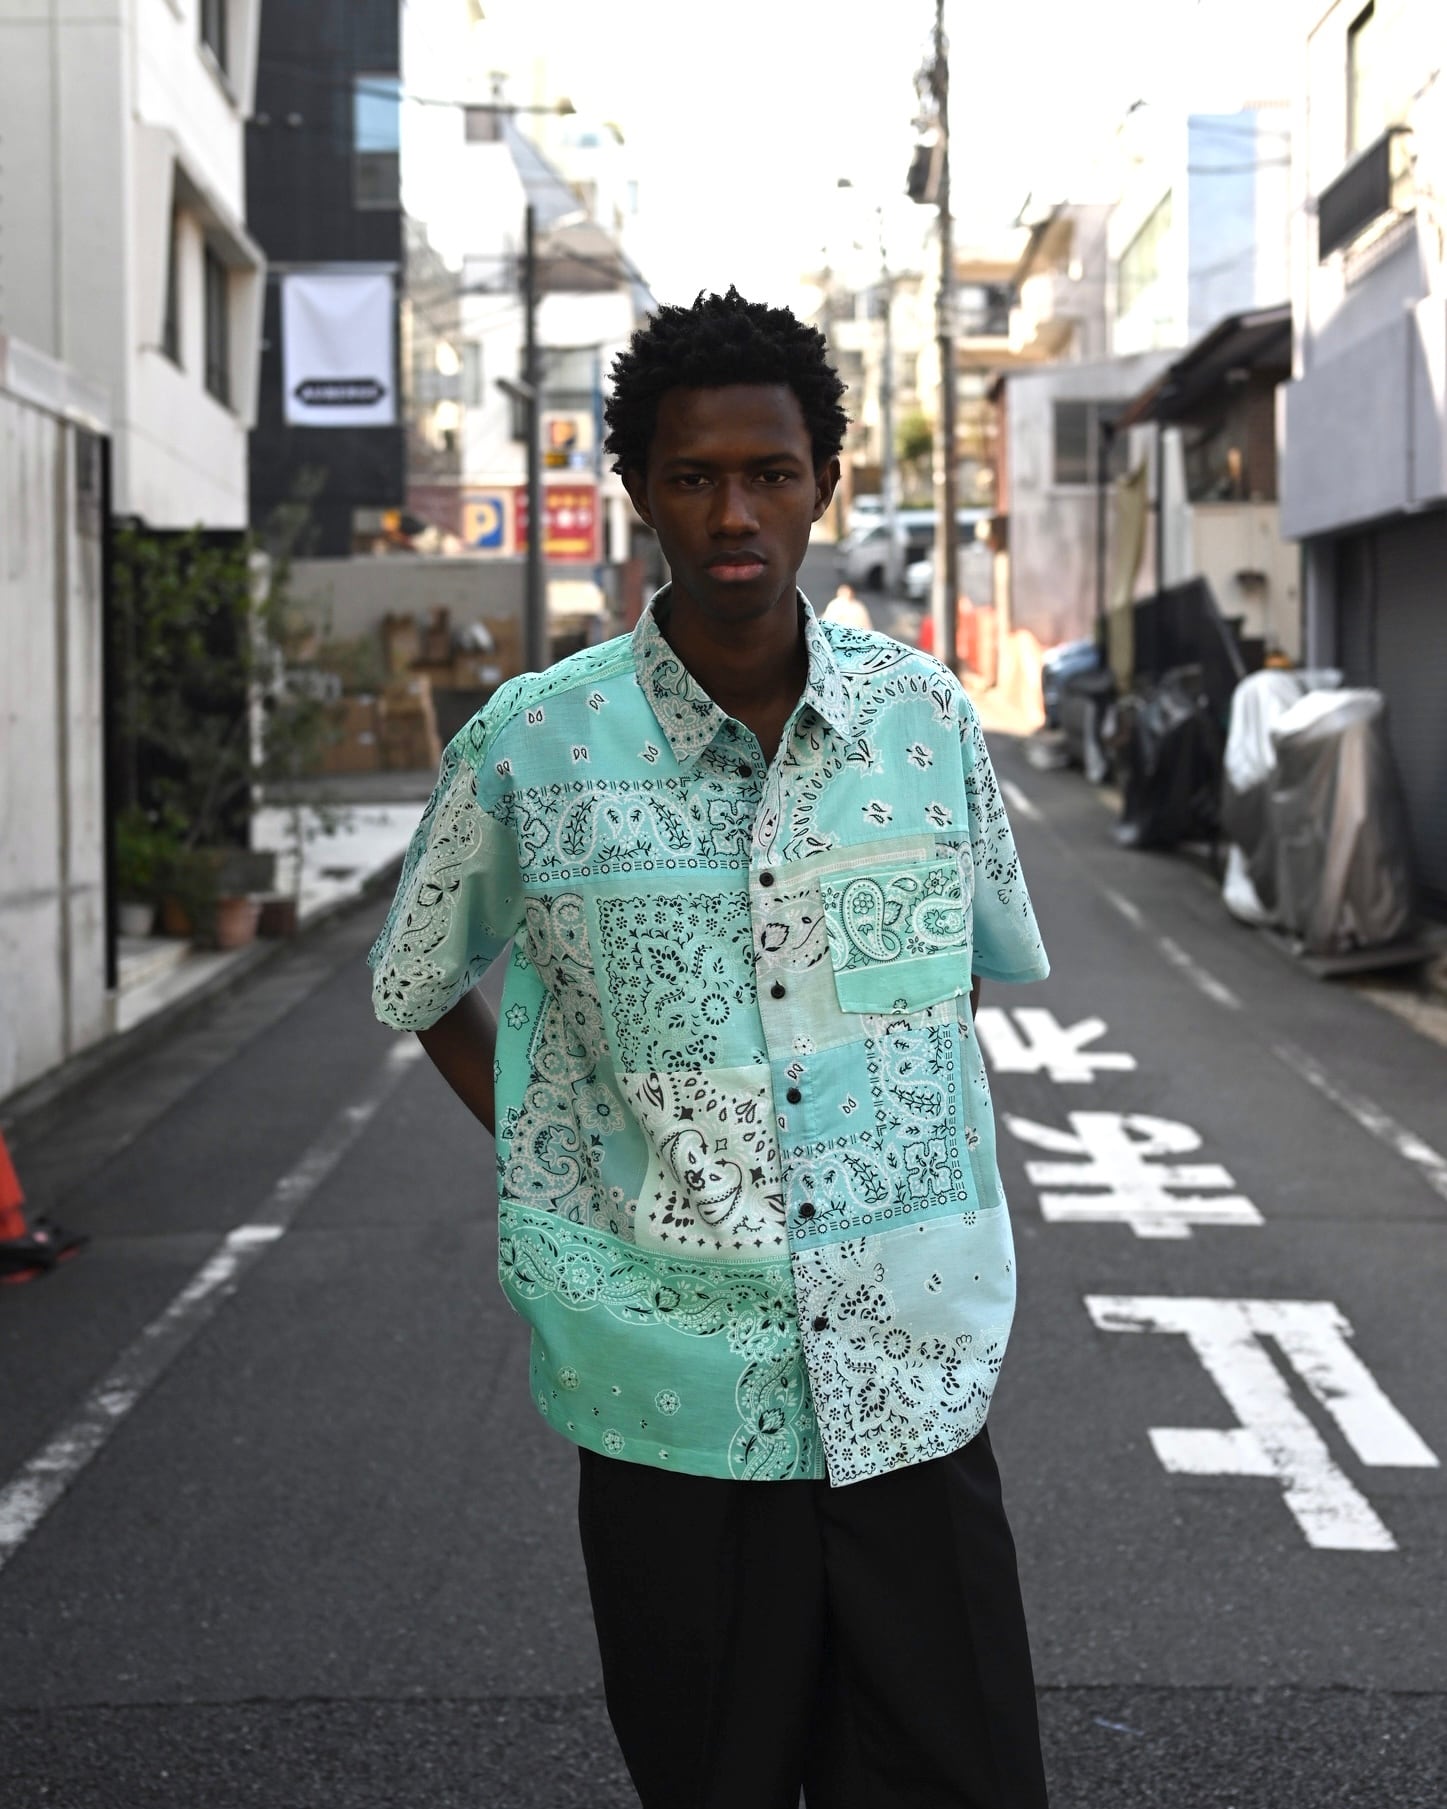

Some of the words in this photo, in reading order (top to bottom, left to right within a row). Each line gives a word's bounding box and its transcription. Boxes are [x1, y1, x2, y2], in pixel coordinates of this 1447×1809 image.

[464, 501, 498, 545] P
[976, 1007, 1440, 1551] 止まれ
